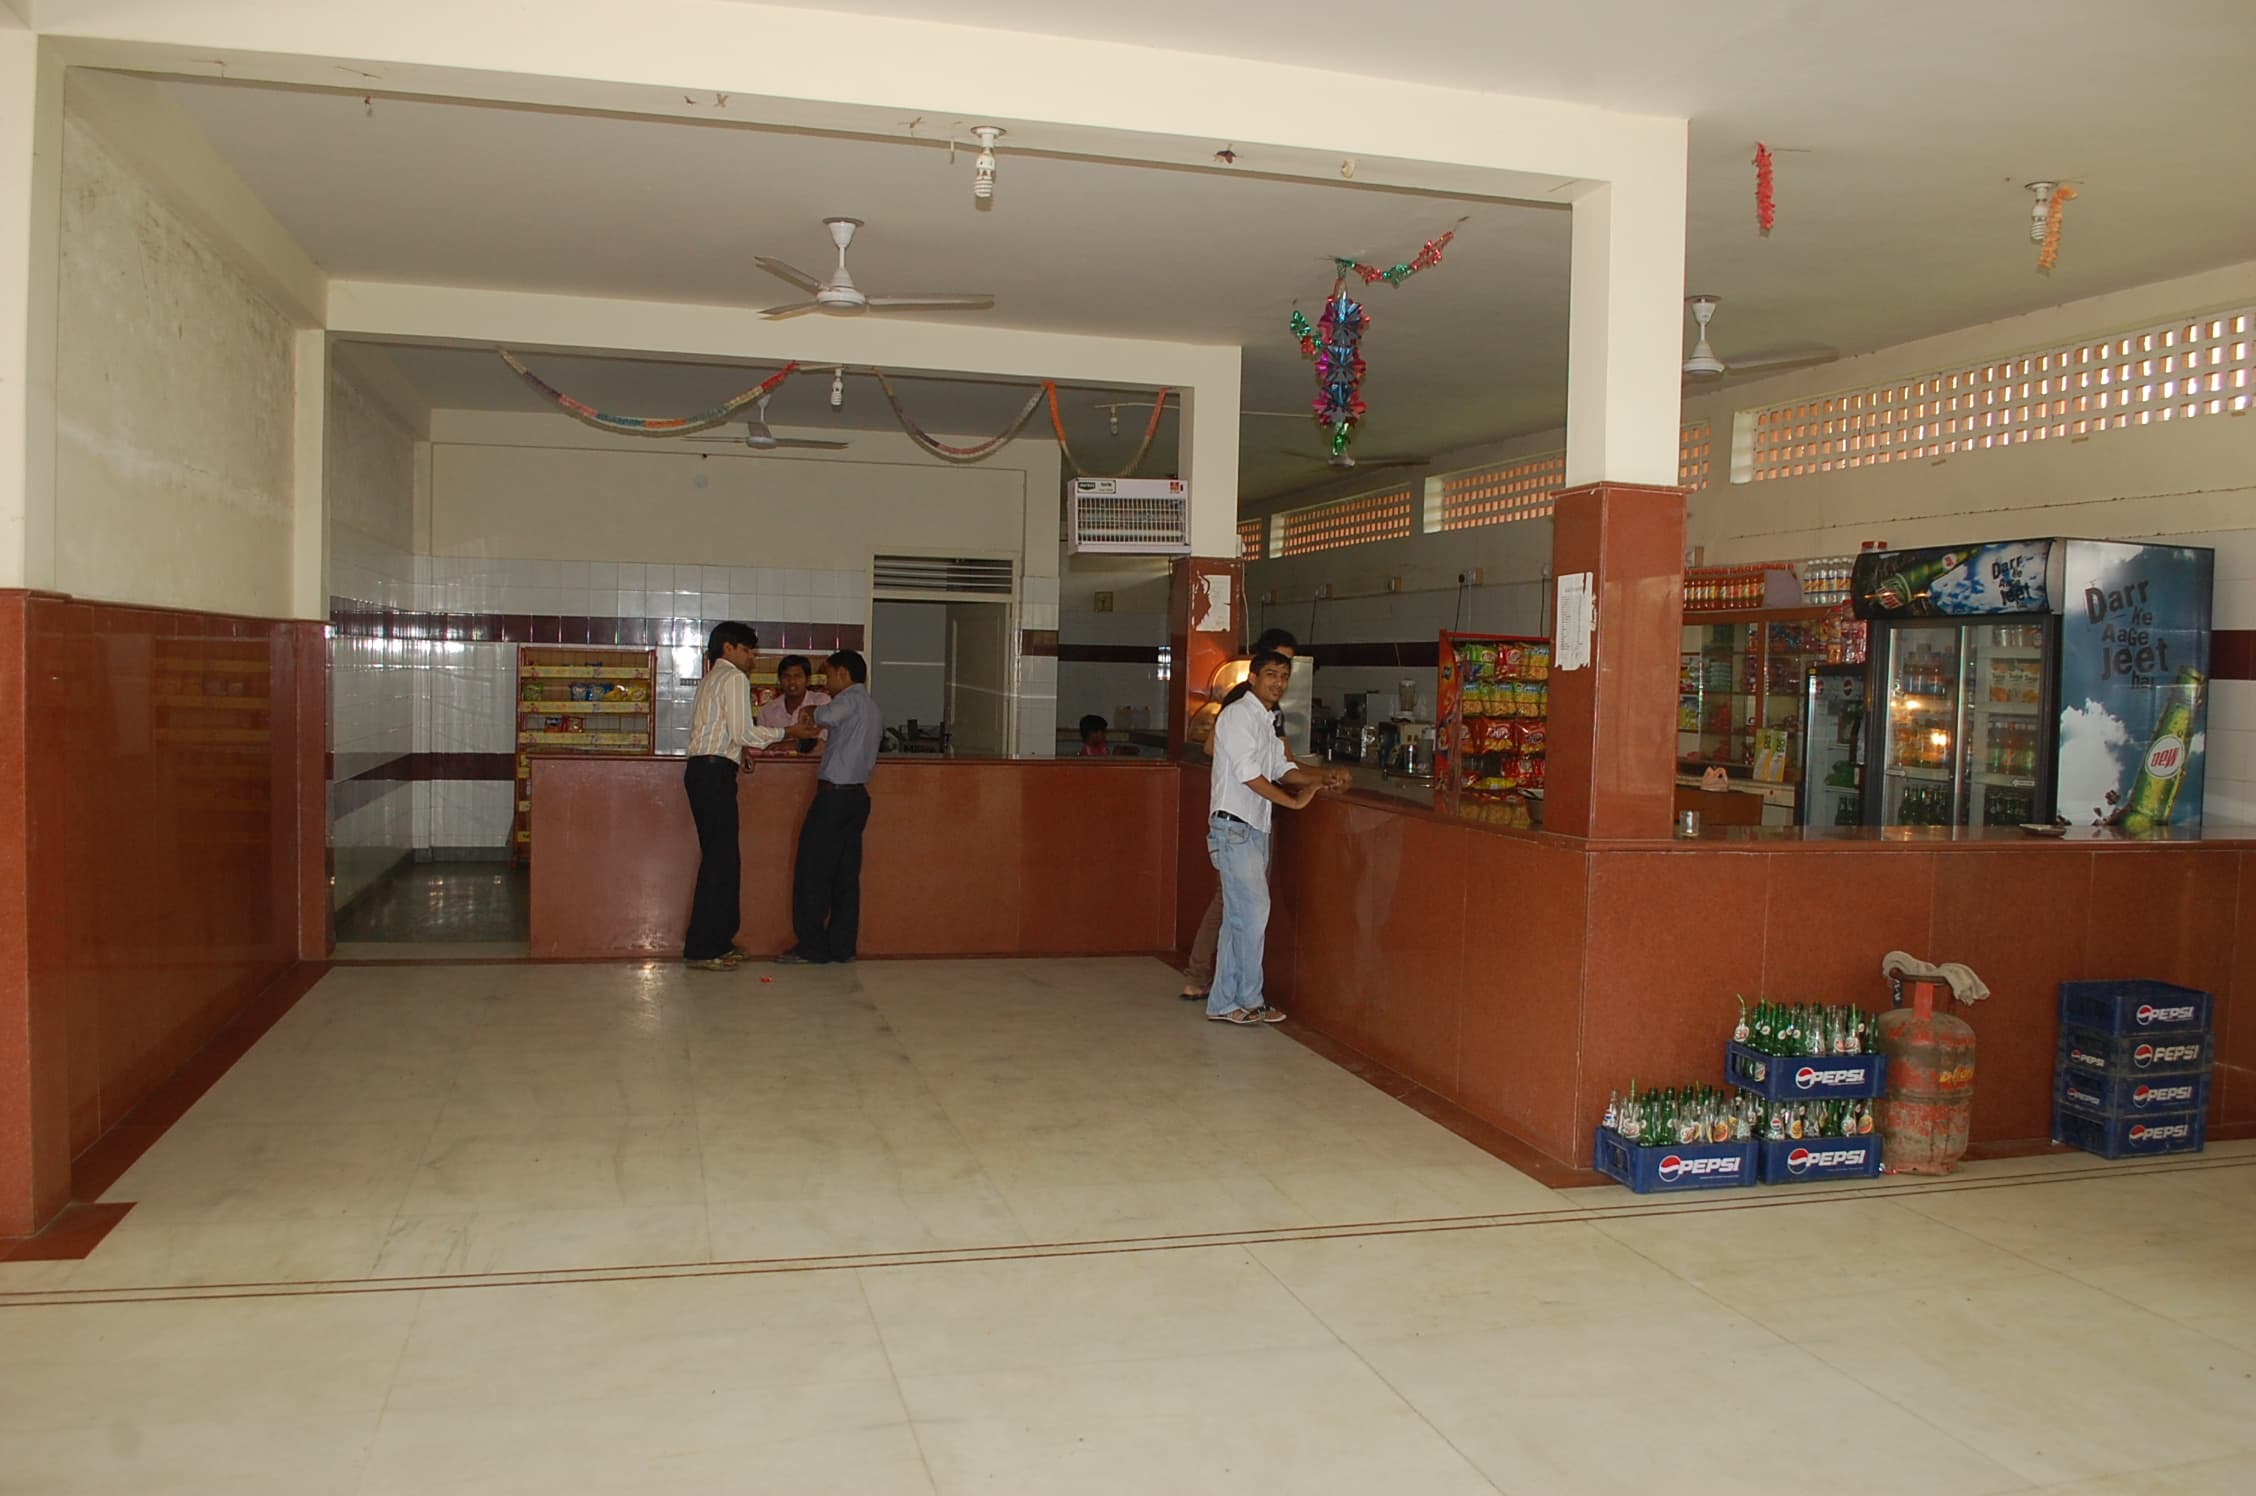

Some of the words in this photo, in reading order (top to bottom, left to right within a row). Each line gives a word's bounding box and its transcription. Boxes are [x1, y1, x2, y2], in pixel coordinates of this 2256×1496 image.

[2085, 580, 2149, 624] Darr
[2150, 1006, 2195, 1020] PEPSI
[1811, 1069, 1865, 1084] PEPSI
[2147, 1086, 2192, 1101] PEPSI
[2142, 1125, 2188, 1140] PEPSI
[1679, 1157, 1740, 1175] PEPSI
[1806, 1150, 1866, 1167] PEPSI
